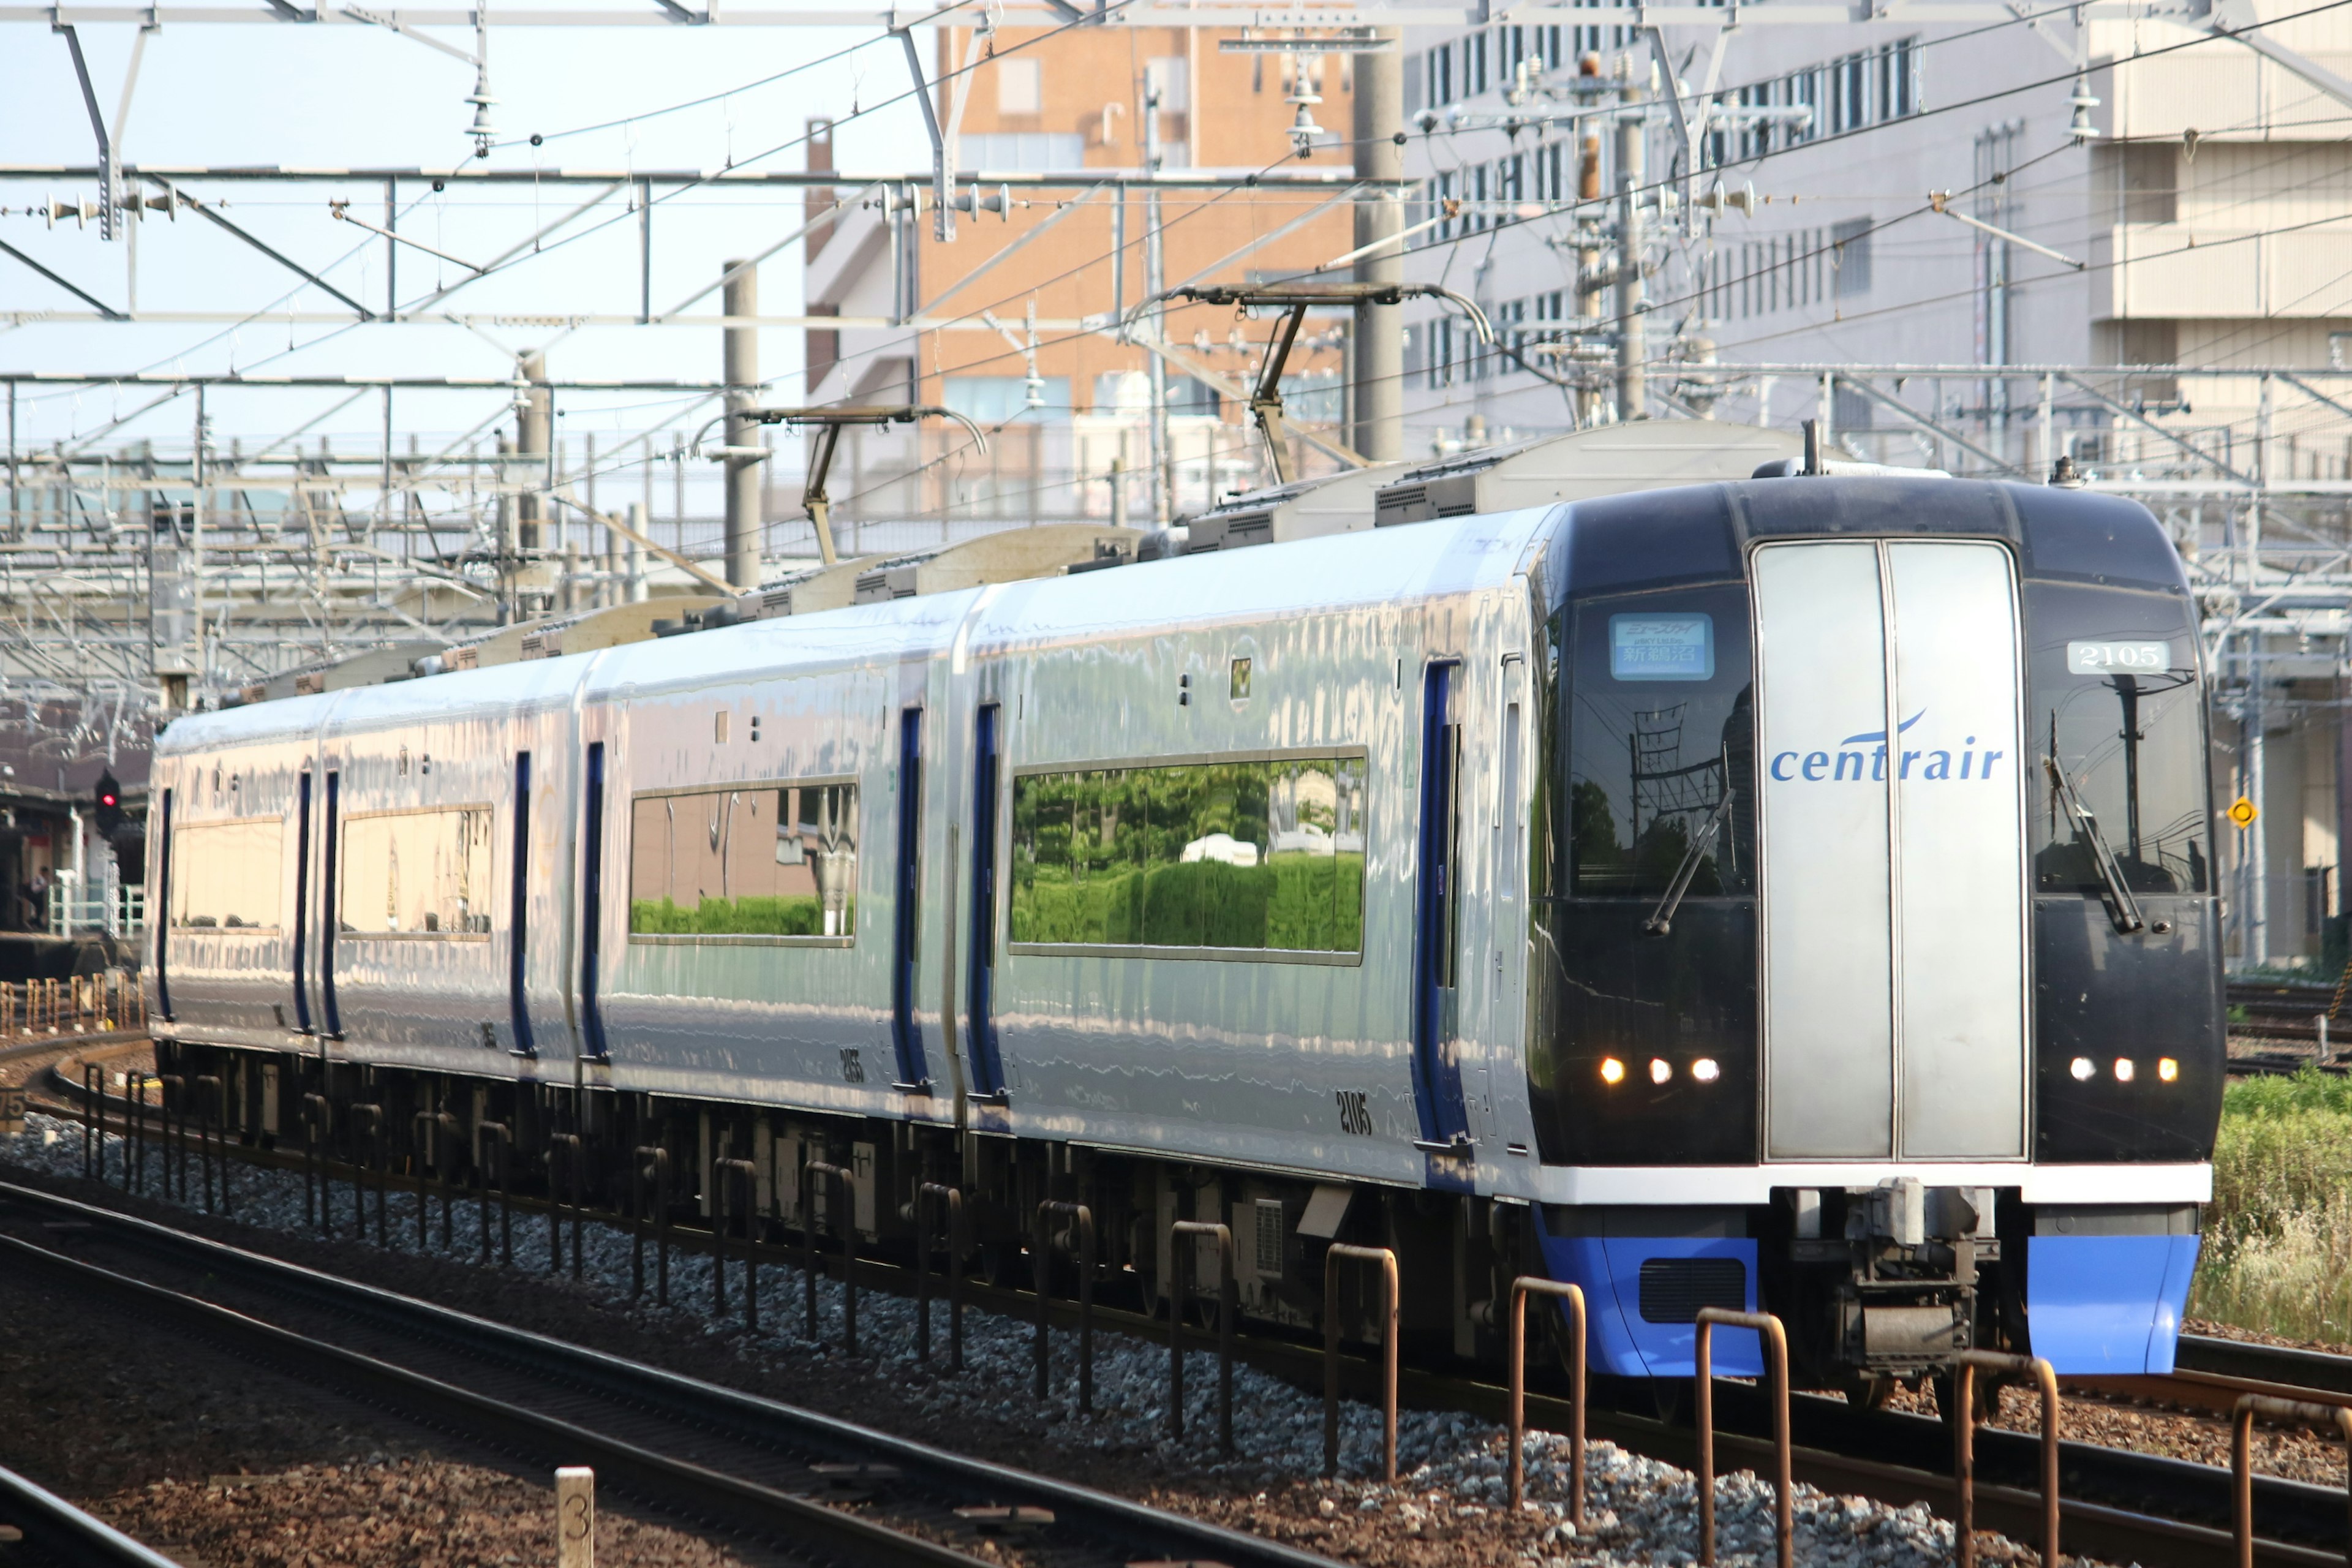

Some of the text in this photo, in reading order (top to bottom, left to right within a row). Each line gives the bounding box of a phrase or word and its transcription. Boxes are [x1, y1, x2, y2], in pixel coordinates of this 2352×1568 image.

[2079, 646, 2160, 666] 2105
[1771, 735, 2003, 781] centrair
[1336, 1091, 1371, 1136] 2105
[565, 1493, 589, 1540] 3
